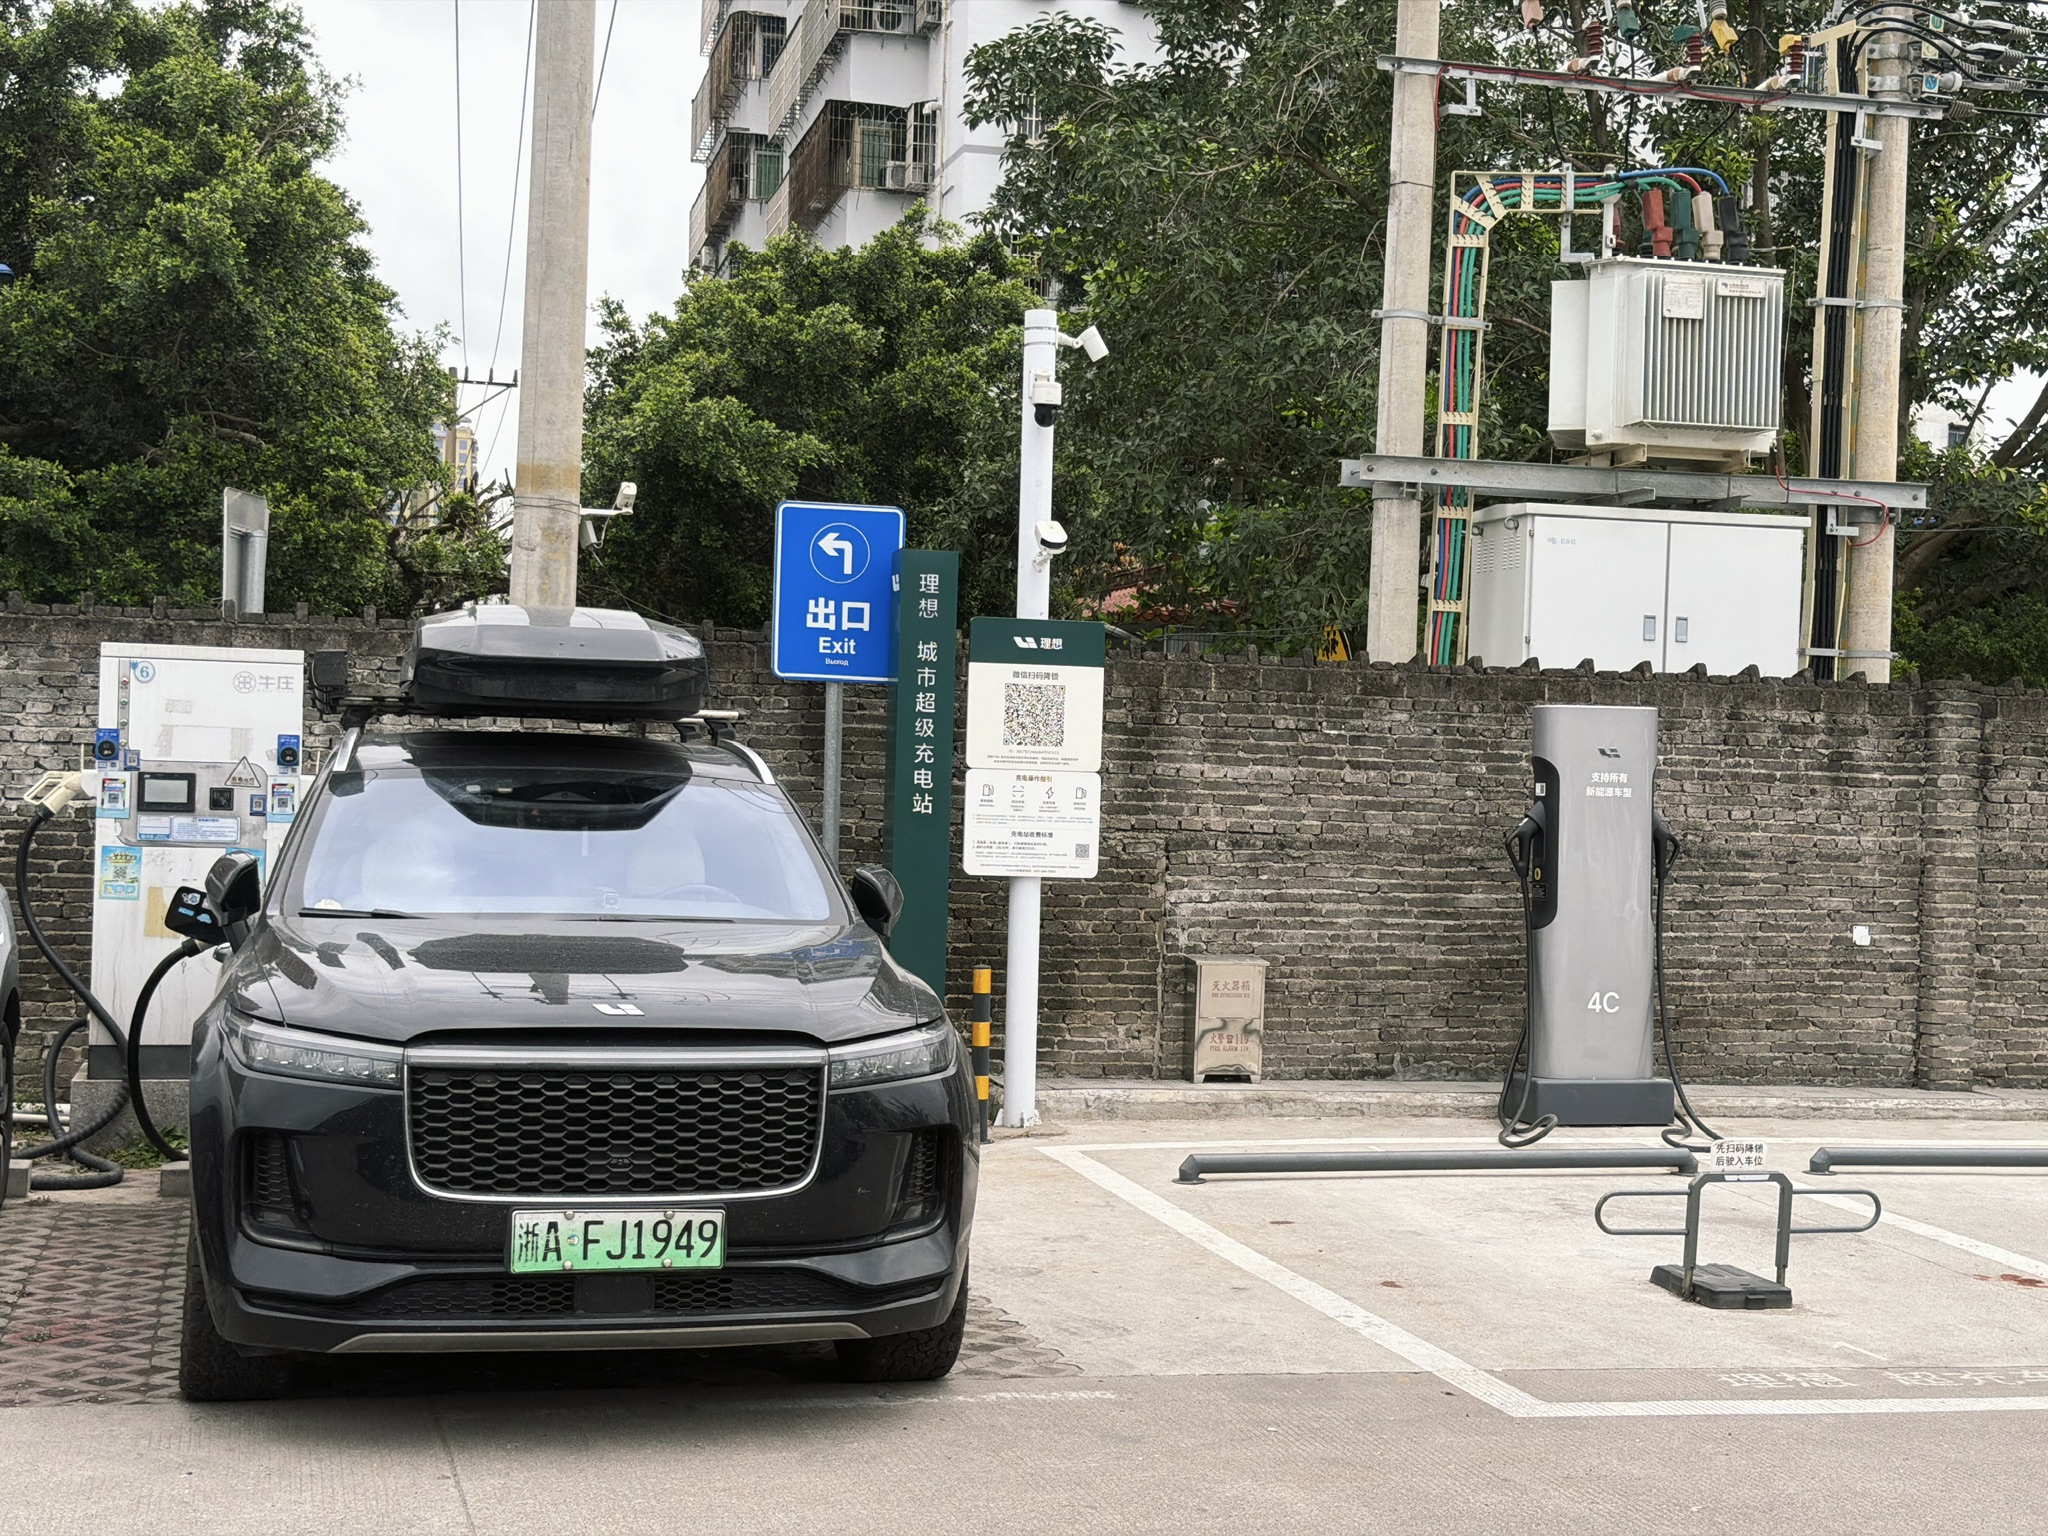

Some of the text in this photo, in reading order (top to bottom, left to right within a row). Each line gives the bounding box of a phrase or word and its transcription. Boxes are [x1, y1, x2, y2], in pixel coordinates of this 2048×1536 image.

[806, 597, 871, 632] 出口
[818, 637, 857, 655] Exit
[1040, 637, 1063, 650] 理想
[825, 657, 849, 667] Выход
[140, 666, 150, 678] 6
[1012, 670, 1060, 681] 微信扫码降锁
[258, 675, 295, 690] 牛庄
[912, 573, 940, 815] 理想 城市超级充电站
[1591, 772, 1628, 783] 支持所有
[1586, 786, 1632, 798] 新能源车型
[1211, 981, 1251, 992] 灭火器箱
[1587, 992, 1620, 1013] 4C
[1716, 1143, 1763, 1154] 先扫码降锁
[1715, 1156, 1763, 1166] 后驶入车位
